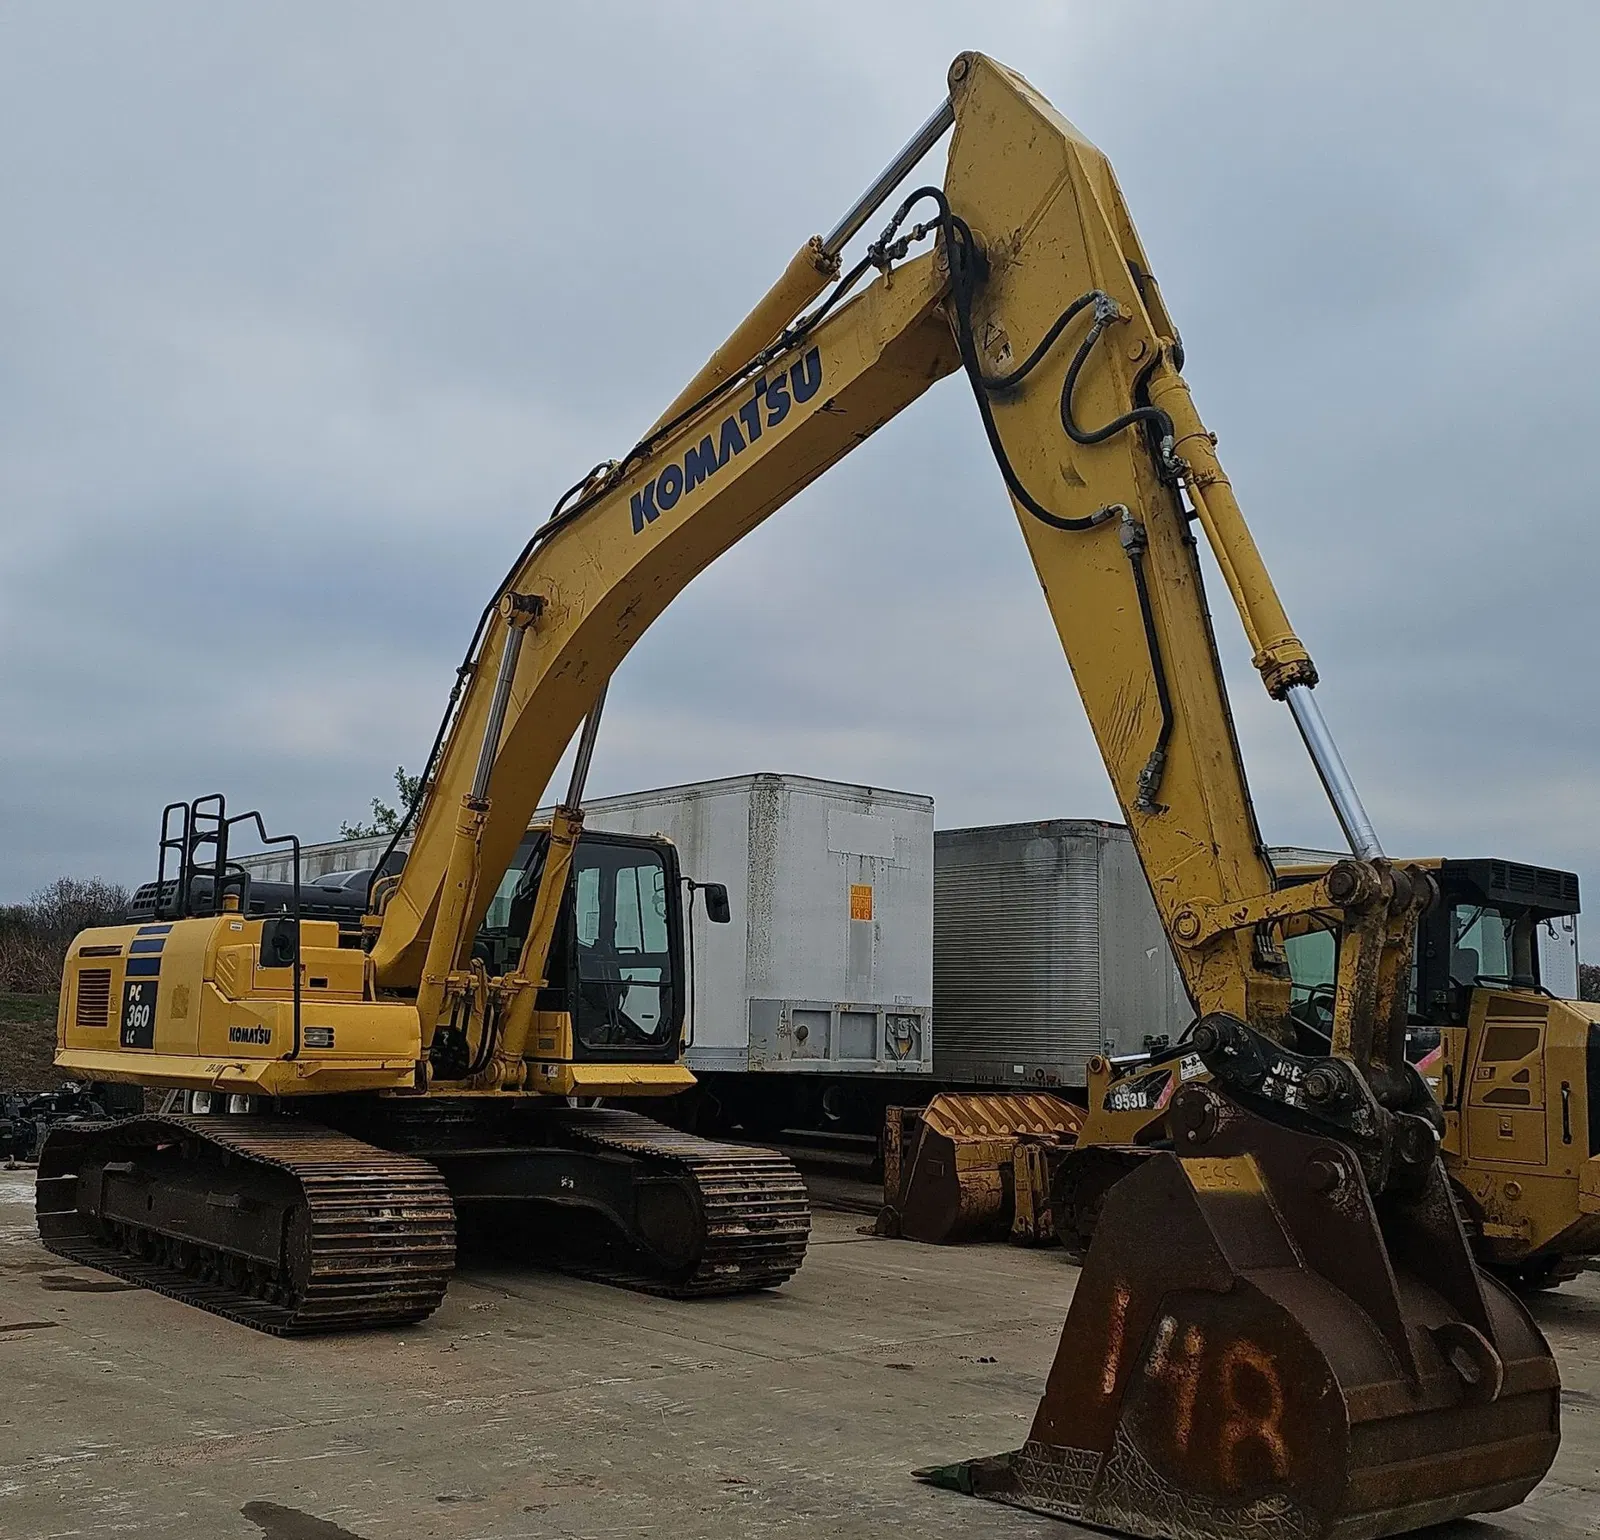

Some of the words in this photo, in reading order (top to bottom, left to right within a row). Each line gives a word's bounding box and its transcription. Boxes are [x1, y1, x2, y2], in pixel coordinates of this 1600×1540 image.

[629, 345, 823, 536] KOMATSU
[128, 984, 142, 1001] PC
[126, 1004, 150, 1028] 360
[126, 1030, 135, 1044] LC
[229, 1023, 272, 1045] KOMATSU
[1114, 1091, 1148, 1110] 953D
